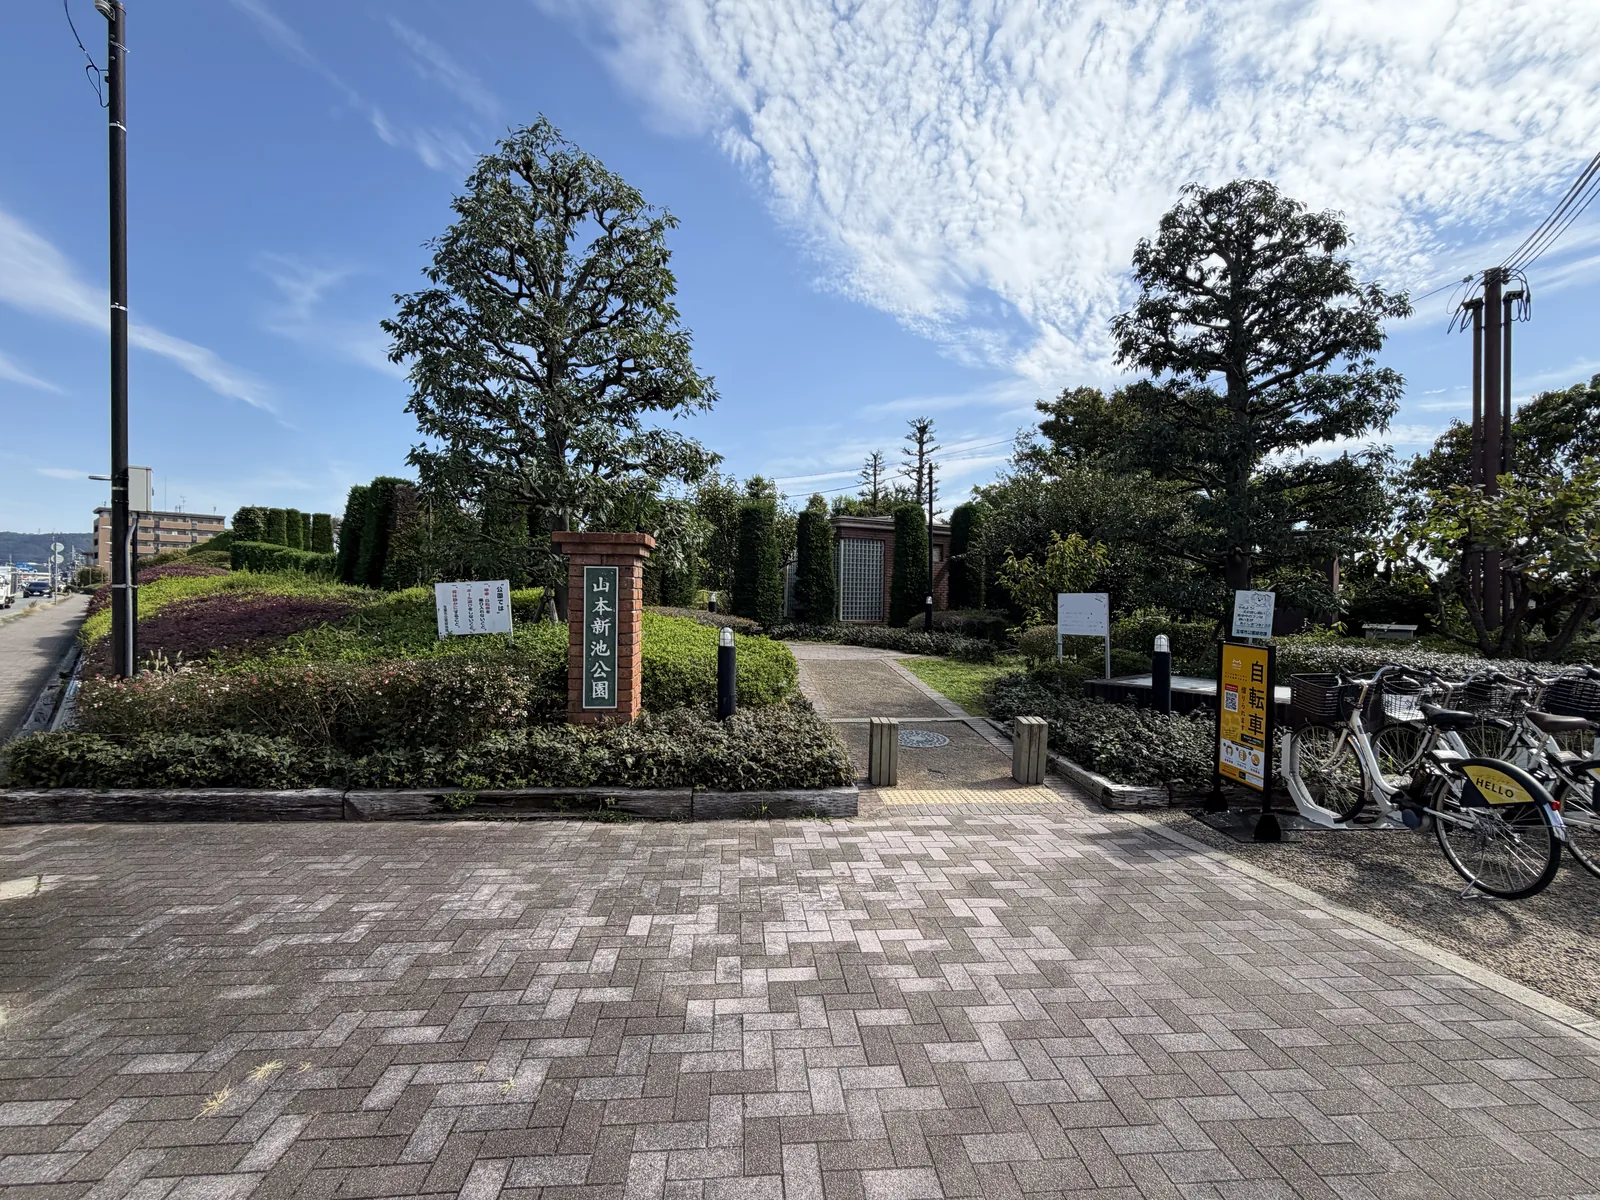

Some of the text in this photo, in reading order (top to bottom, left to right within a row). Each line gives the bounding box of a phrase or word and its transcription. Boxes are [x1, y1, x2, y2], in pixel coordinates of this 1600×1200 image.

[591, 576, 612, 699] 山本新池公園
[1248, 661, 1265, 736] 自転車
[1475, 777, 1514, 798] HELLO
